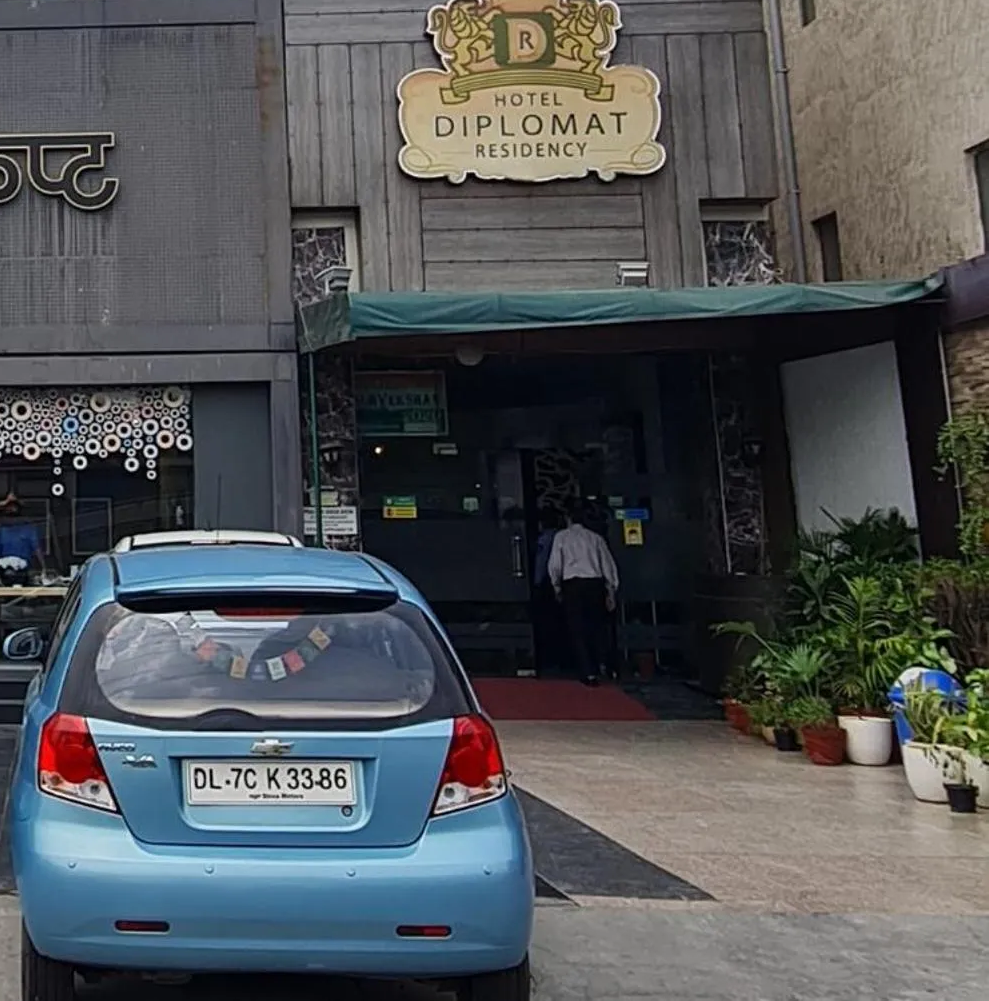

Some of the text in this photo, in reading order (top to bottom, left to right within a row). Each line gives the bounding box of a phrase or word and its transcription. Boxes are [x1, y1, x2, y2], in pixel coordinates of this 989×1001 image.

[495, 92, 563, 107] HOTEL
[435, 112, 628, 137] DIPLOMAT
[476, 142, 587, 158] RESIDENCY
